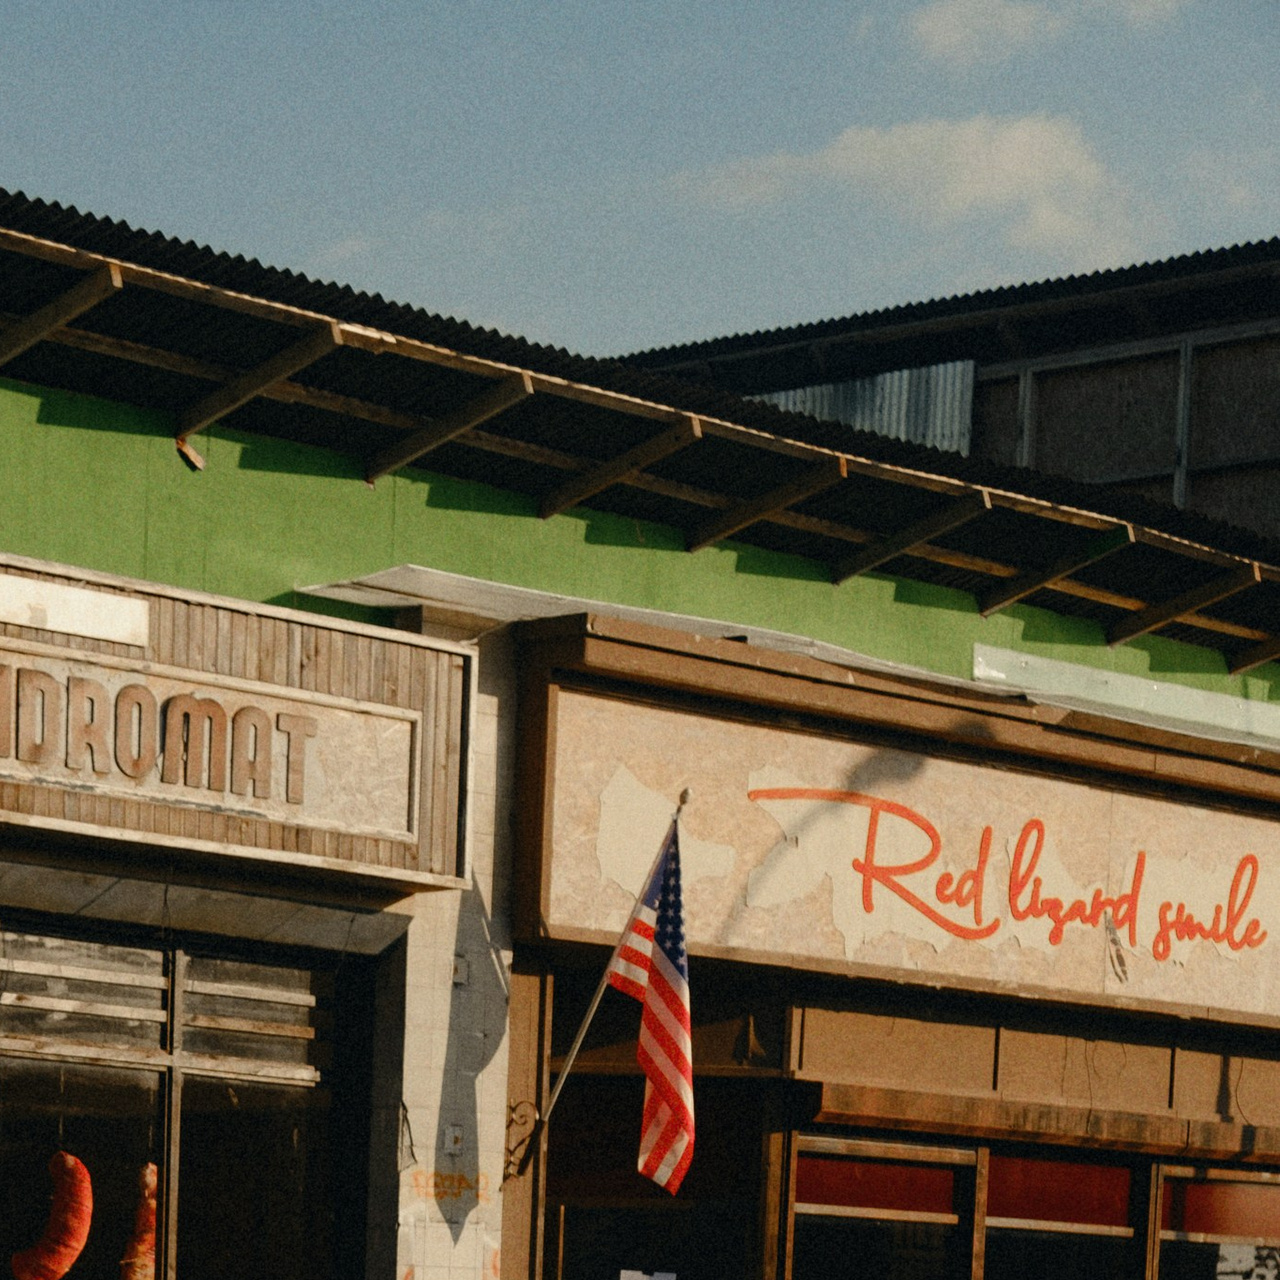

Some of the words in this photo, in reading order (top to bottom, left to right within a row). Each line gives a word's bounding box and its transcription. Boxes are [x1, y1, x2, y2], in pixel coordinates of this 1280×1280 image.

[748, 787, 1001, 940] Red
[1008, 818, 1147, 945] lizard
[1152, 853, 1268, 962] smile
